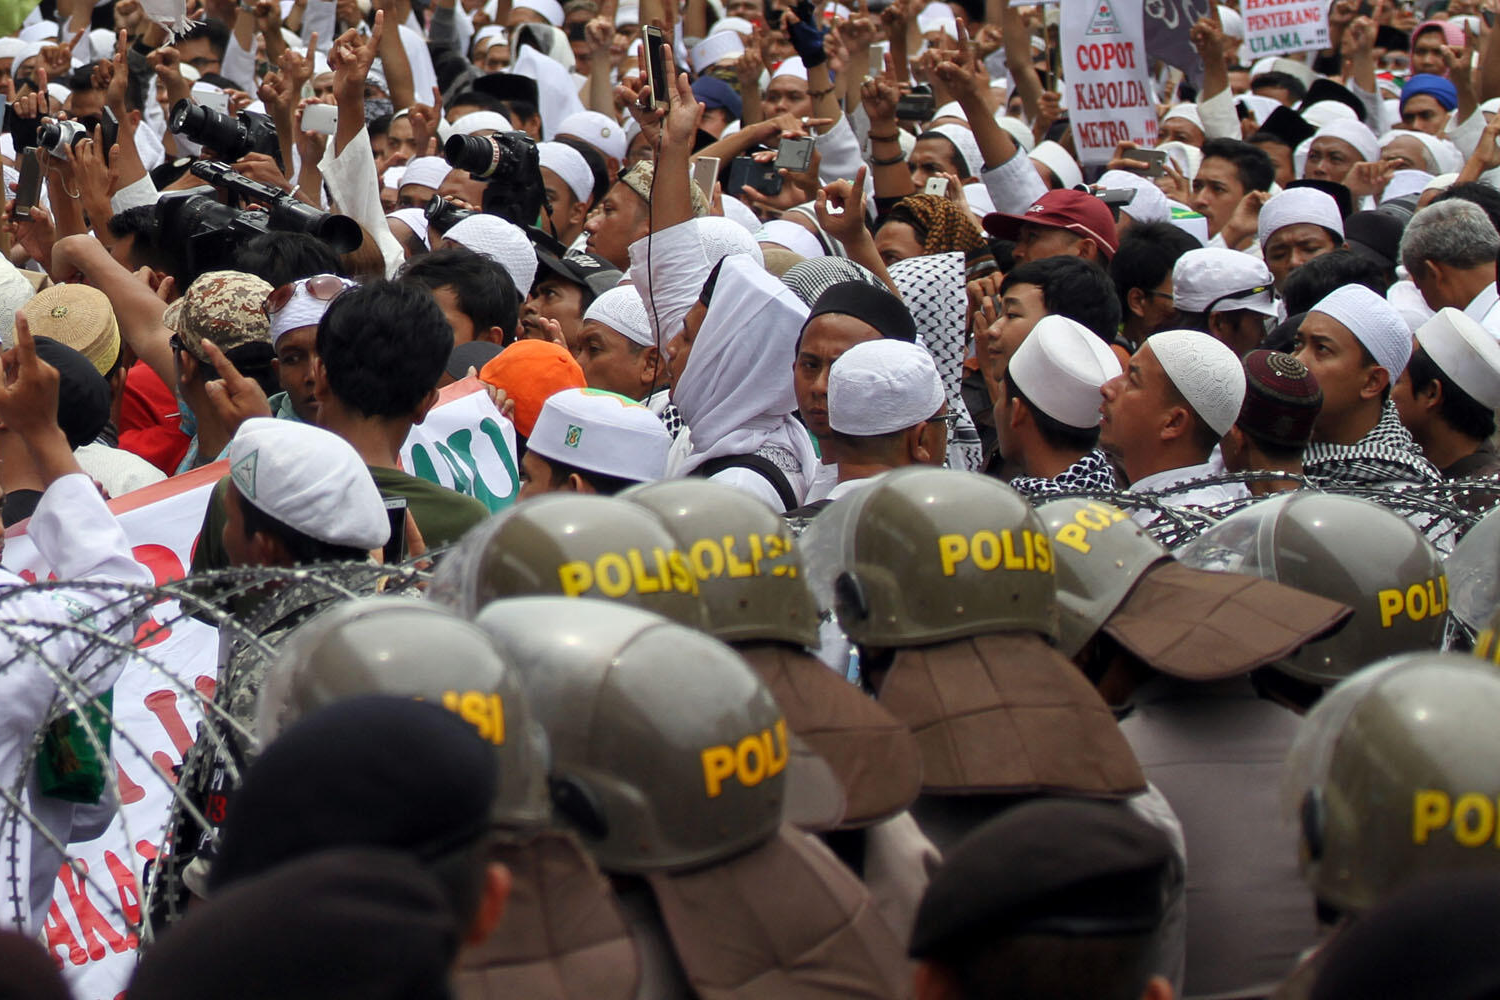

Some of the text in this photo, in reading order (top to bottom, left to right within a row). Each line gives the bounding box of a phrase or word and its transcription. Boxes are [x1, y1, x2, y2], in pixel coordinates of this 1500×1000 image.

[1247, 7, 1320, 32] PENYERANG
[1076, 42, 1135, 71] COPOT
[1074, 80, 1148, 110] KAPOLDA
[938, 528, 1055, 577] POLIS
